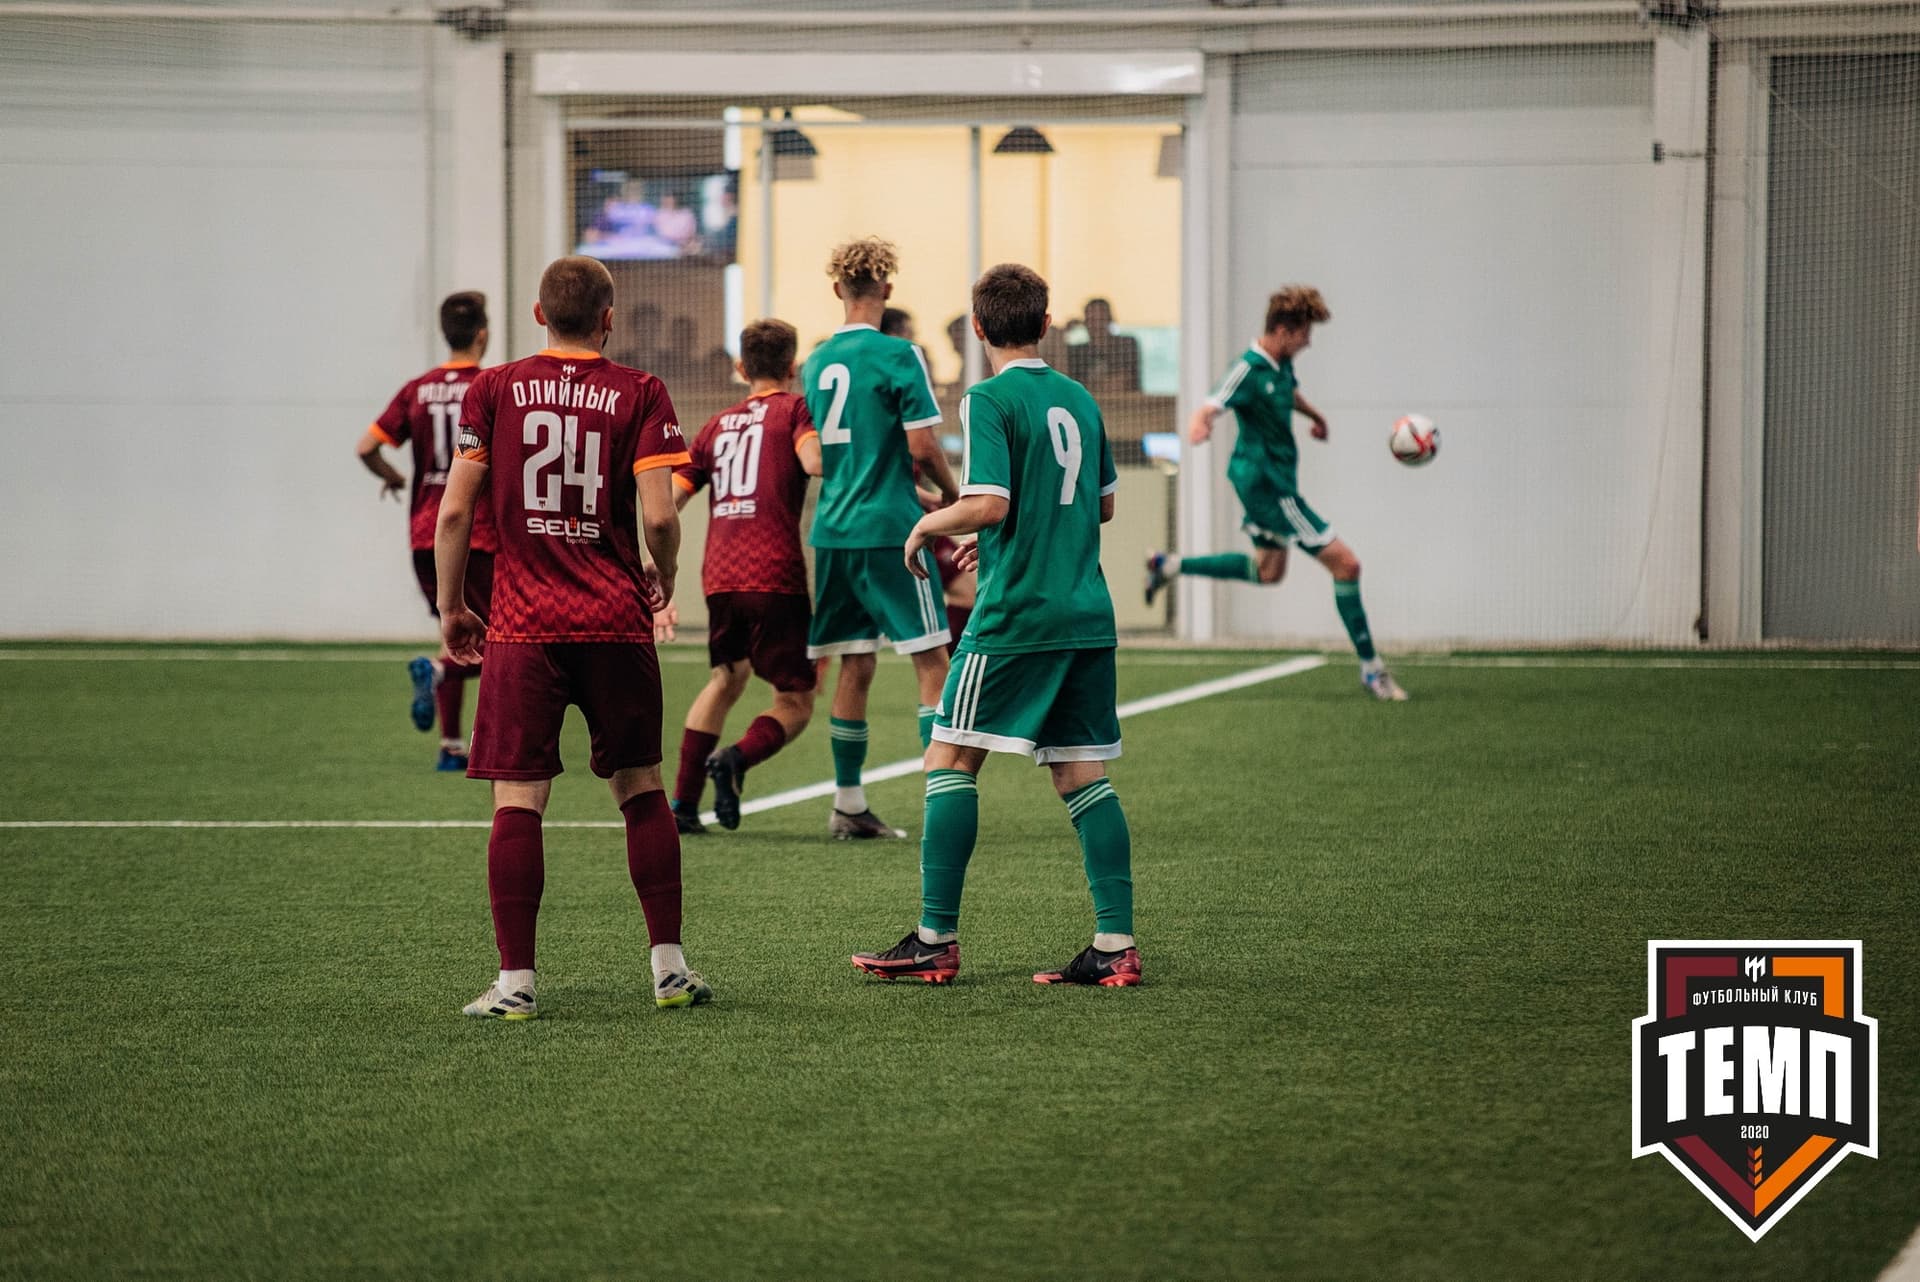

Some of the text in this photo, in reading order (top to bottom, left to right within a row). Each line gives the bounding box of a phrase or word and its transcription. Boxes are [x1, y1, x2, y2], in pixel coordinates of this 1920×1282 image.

[512, 375, 621, 415] ОЛИЙНЫК
[818, 363, 852, 445] 2
[523, 410, 603, 515] 24
[712, 424, 764, 501] 30
[1046, 406, 1083, 505] 9
